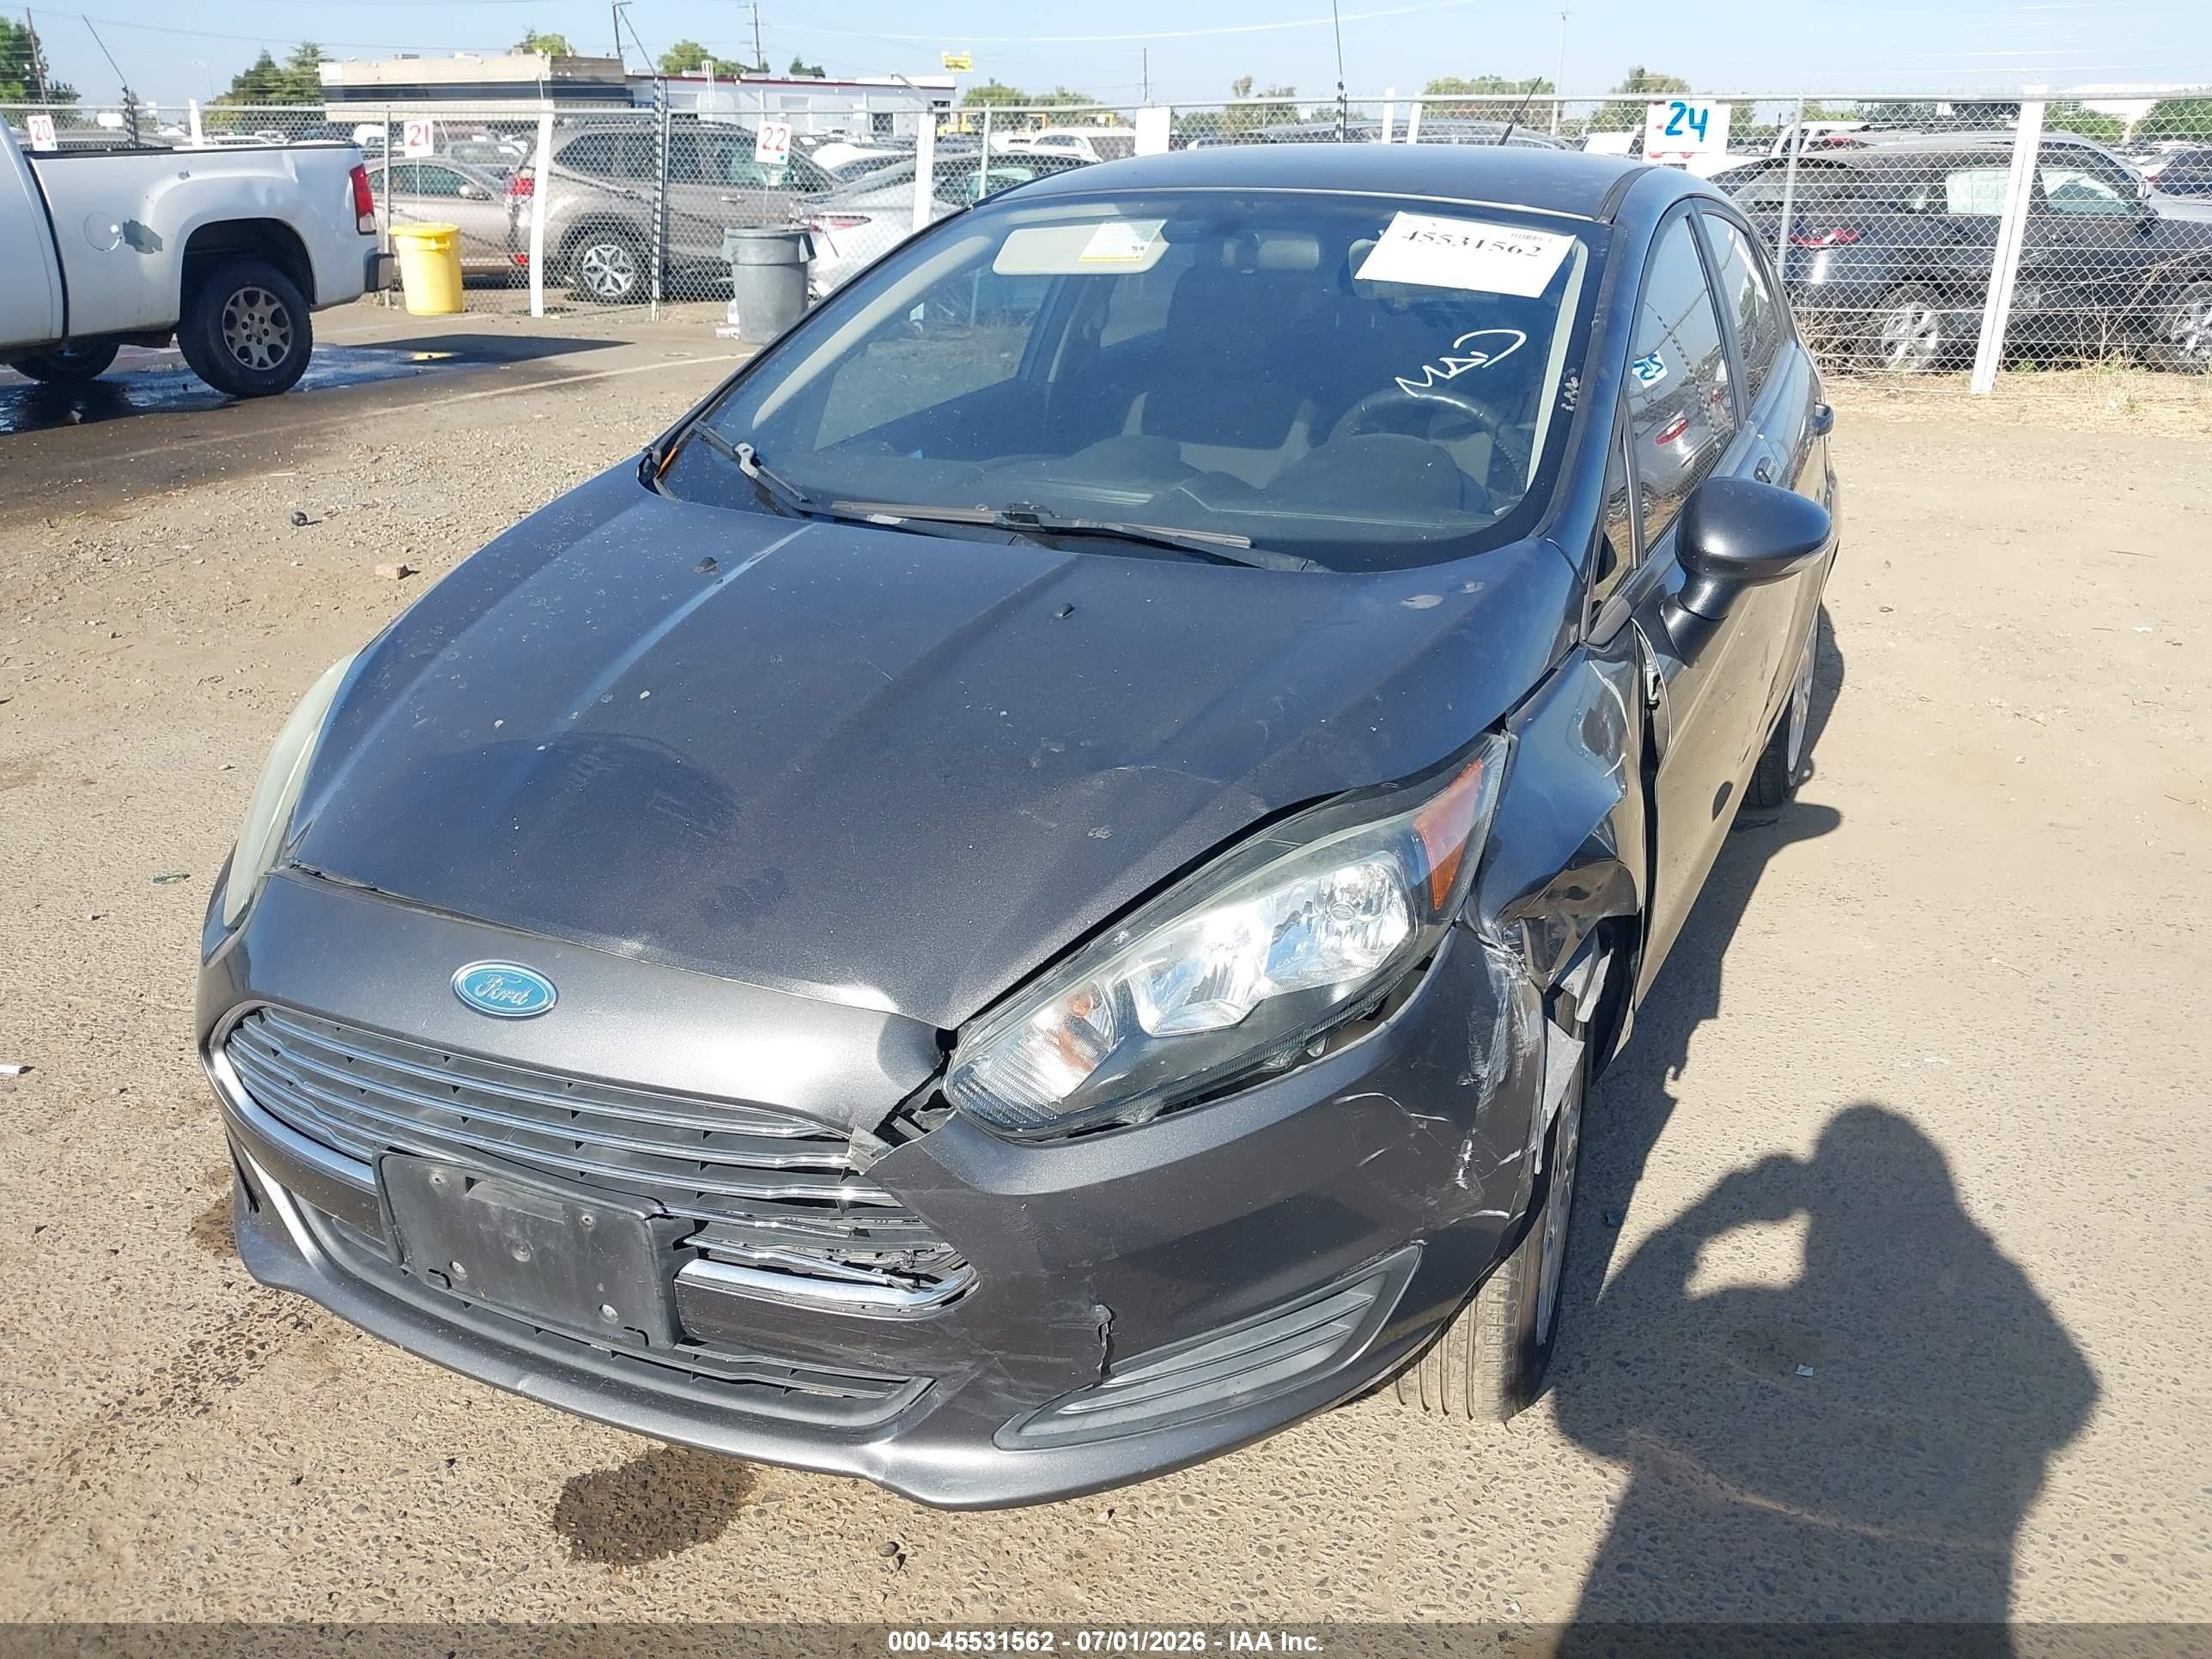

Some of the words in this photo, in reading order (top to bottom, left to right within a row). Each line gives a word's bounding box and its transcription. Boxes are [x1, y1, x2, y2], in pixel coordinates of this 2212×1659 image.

[33, 119, 52, 142] 20
[1665, 101, 1708, 143] 24
[409, 124, 429, 147] 21
[762, 126, 787, 151] 22
[474, 972, 533, 1006] Ford
